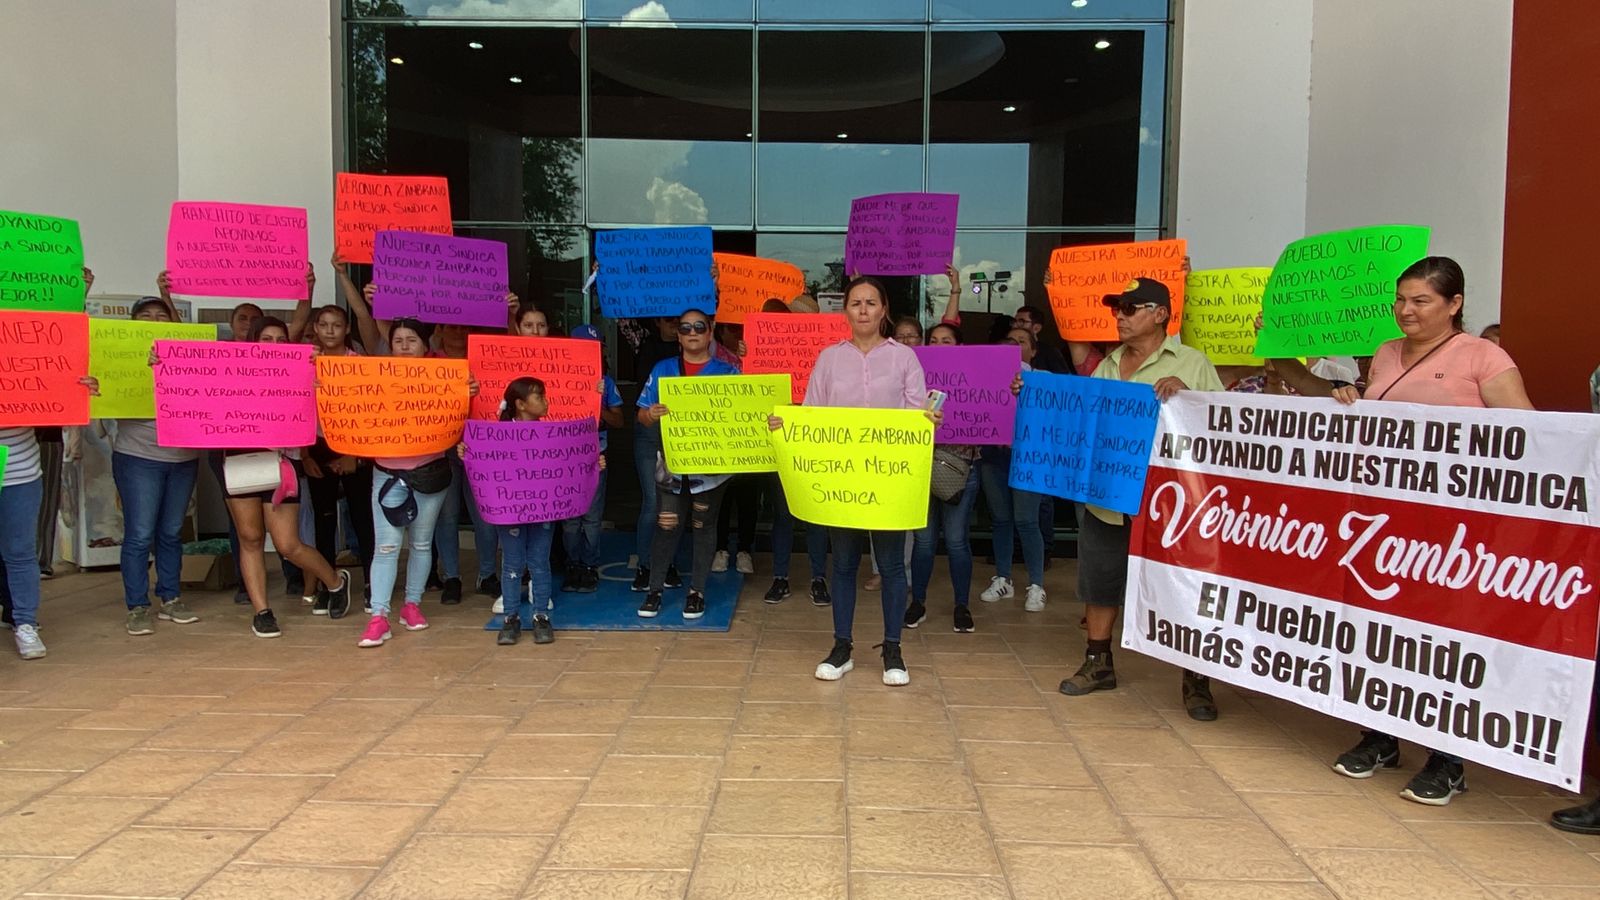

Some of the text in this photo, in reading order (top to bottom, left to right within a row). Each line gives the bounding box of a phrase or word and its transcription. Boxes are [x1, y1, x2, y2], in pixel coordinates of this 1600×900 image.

[339, 178, 446, 196] VERONICA ZAMBRANO
[338, 200, 438, 214] LA MEJOR SINDICA
[917, 201, 938, 211] QUE
[181, 207, 306, 229] RANCHITO DE CASTRO
[215, 228, 277, 242] APOYAMOS
[17, 239, 76, 255] SINDICA
[176, 242, 298, 255] A NUESTRA SINDICA
[382, 234, 496, 262] NUESTRA SINDICA
[1055, 245, 1180, 264] NUESTRA SINDICA
[1283, 235, 1403, 265] PUEBLO VIEJO
[176, 259, 304, 270] VERONICA ZAMBRANO
[377, 255, 497, 277] VERONICA ZAMBRANO
[0, 271, 79, 288] ZAMBRANO
[1051, 271, 1109, 287] PERSONA
[1275, 260, 1380, 288] APOYAMOS A
[376, 285, 425, 298] TRABAJA
[1272, 288, 1332, 306] NUESTRA
[414, 301, 462, 314] PUEBLO
[1052, 297, 1076, 308] QUE
[757, 321, 849, 333] PRESIDENTE NO
[1060, 317, 1108, 330] NUESTRO
[1201, 314, 1254, 328] TRABAJA
[1271, 311, 1334, 329] VERONICA
[757, 336, 826, 346] DUDAMOS DE
[1322, 326, 1375, 345] MEJOR!
[155, 342, 302, 360] LAGUNERAS DE GAMBINO
[480, 344, 572, 360] PRESIDENTE
[755, 348, 814, 357] APOYO PARA
[1201, 341, 1254, 354] PUEBLO
[159, 364, 290, 377] APOYANDO A NUESTRA
[320, 359, 464, 380] NADIE MEJOR QUE
[481, 361, 595, 376] ESTAMOS CON USTED
[753, 360, 794, 368] SINDICA
[156, 382, 311, 397] SINDICA VERONICA ZAMBRANO
[319, 383, 456, 397] NUESTRA SINDICA
[566, 381, 592, 391] CON
[666, 383, 776, 397] LA SINDICATURA DE
[319, 399, 461, 414] VERONICA ZAMBRANO
[709, 398, 732, 408] NIO
[1019, 385, 1159, 420] VERONICA ZAMBRANO
[160, 404, 307, 422] SIEMPRE APOYANDO AL
[669, 410, 769, 423] RECONOCE COMO
[200, 424, 261, 435] DEPORTE
[322, 416, 408, 429] PARA SEGUIR
[324, 431, 347, 443] POR
[352, 434, 400, 445] NUESTRO
[467, 422, 539, 442] VERONICA
[668, 426, 769, 438] NUESTRA UNICA Y
[782, 422, 931, 446] VERONICA ZAMBRANO
[941, 423, 1000, 440] SINDICA
[1208, 404, 1526, 461] LA SINDICATURA DE NIO
[669, 440, 773, 452] LEGITIMA SINDICA
[1015, 424, 1145, 456] LA MEJOR SINDICA
[467, 443, 596, 461] SIEMPRE TRABAJANDO
[1012, 449, 1086, 471] TRABAJANDO
[671, 456, 727, 467] A VERONICA
[793, 456, 912, 476] NUESTRA MEJOR
[468, 462, 596, 482] CON EL PUEBLO Y POR
[1012, 466, 1057, 488] POR EL
[1159, 433, 1589, 513] APOYANDO A NUESTRA SINDICA
[472, 483, 581, 500] EL PUEBLO CON
[811, 483, 880, 505] SINDICA
[541, 499, 573, 512] Y POR
[1149, 480, 1592, 610] Verónica Zambrano
[1197, 581, 1487, 690] El Pueblo Unido
[1146, 610, 1563, 765] Jamás será Vencido!!!
